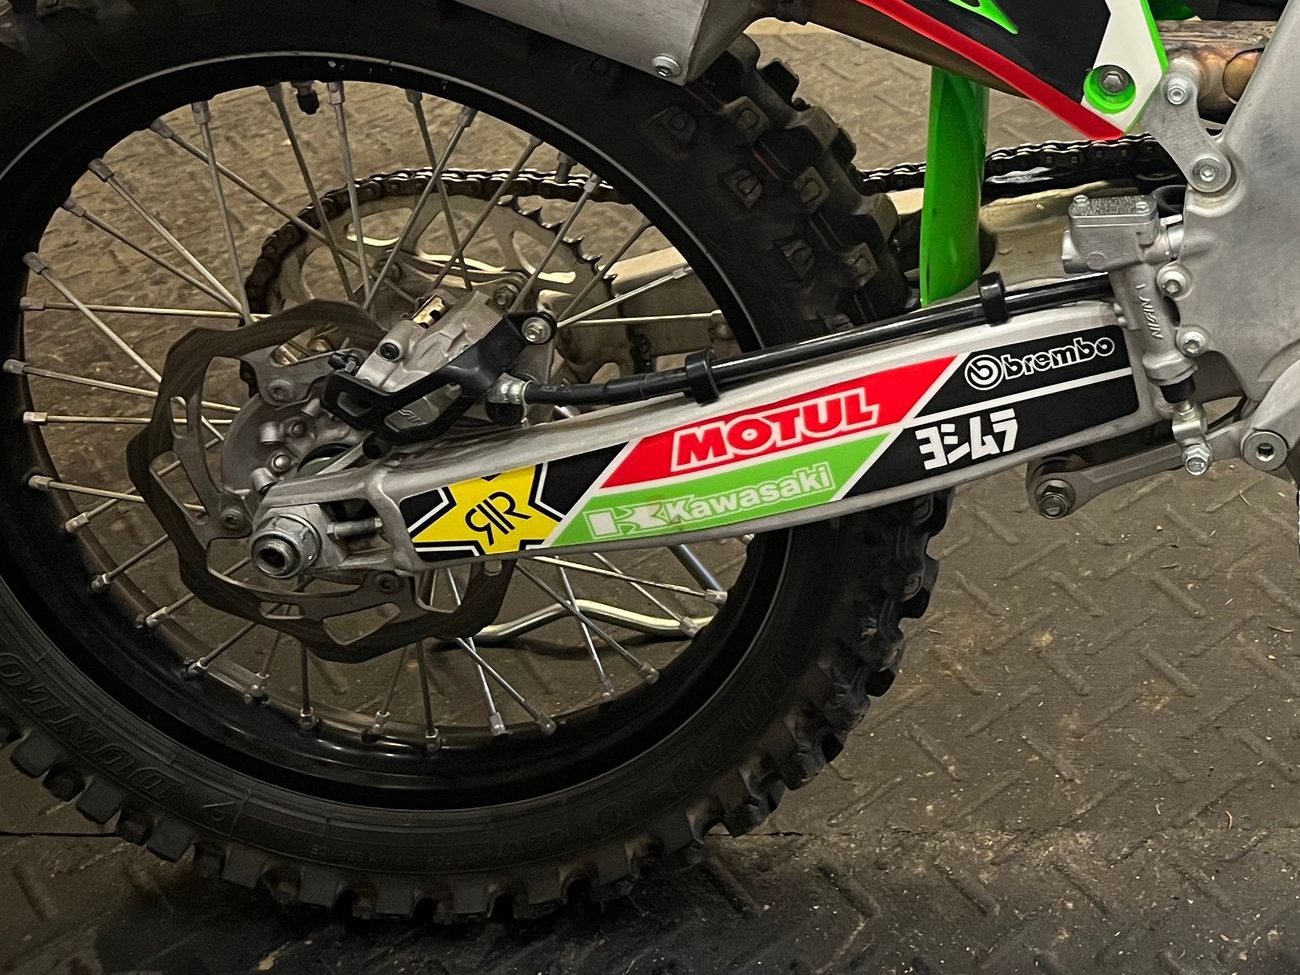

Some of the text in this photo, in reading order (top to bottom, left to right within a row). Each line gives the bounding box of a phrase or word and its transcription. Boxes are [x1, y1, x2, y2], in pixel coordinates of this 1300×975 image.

[1001, 337, 1115, 380] brembo
[670, 388, 879, 472] MOTUL
[915, 408, 1018, 470] ヨシムラ
[664, 462, 835, 524] Kawasaki
[0, 653, 187, 802] DUNLO
